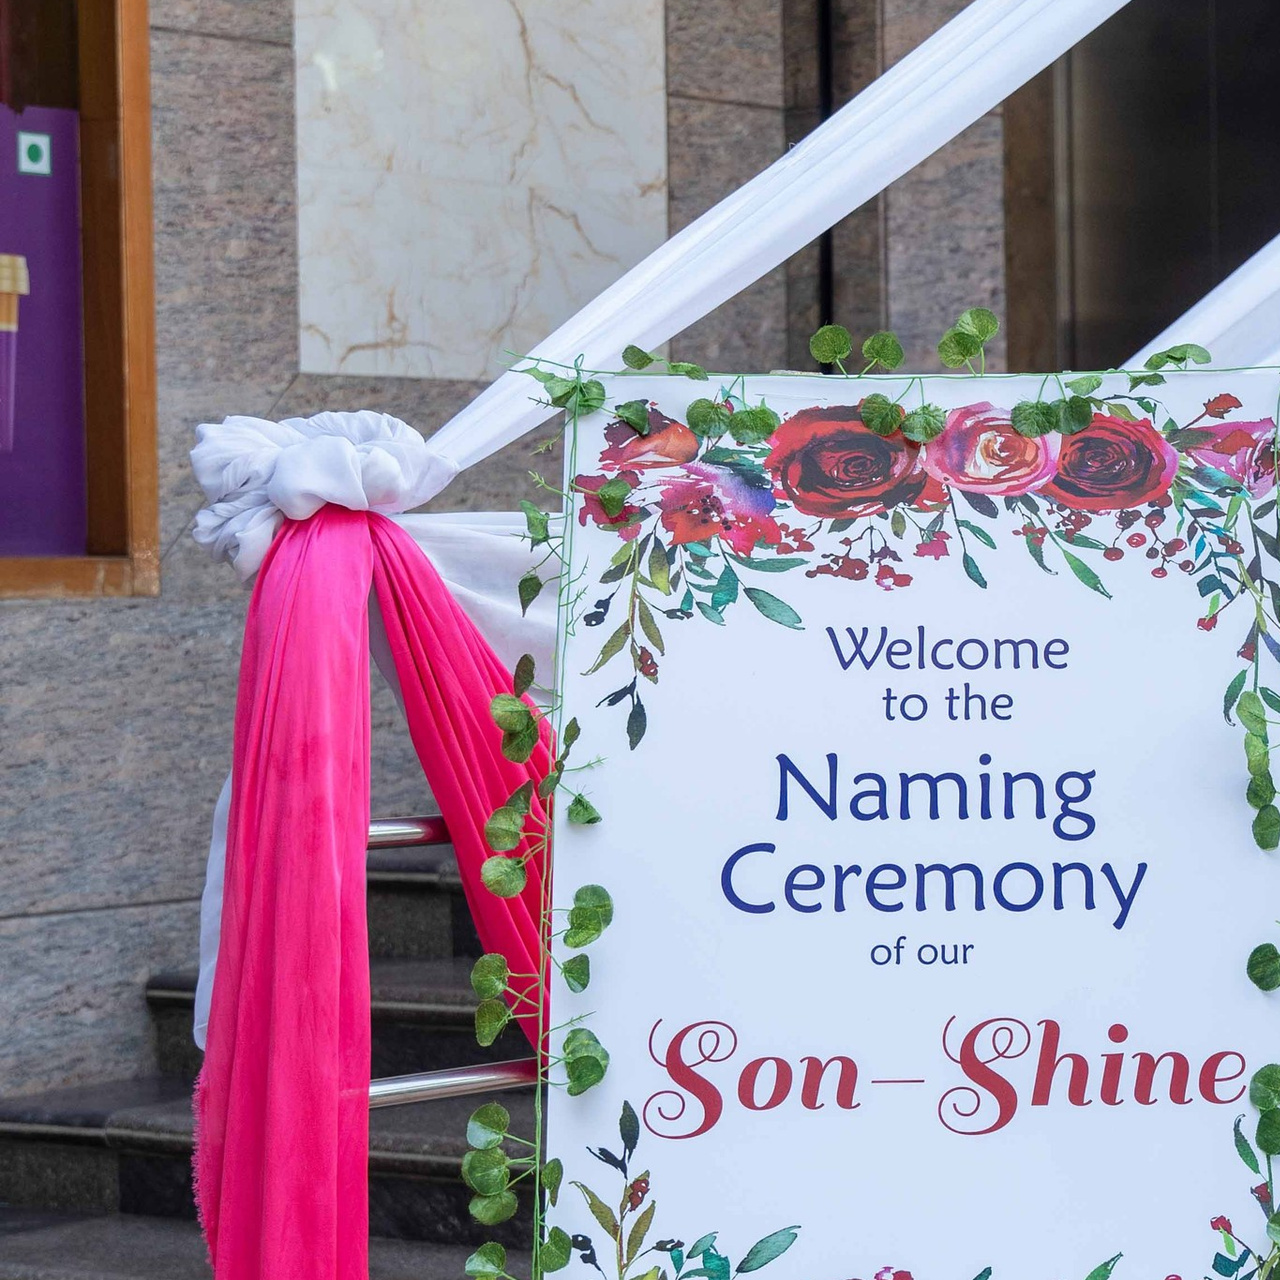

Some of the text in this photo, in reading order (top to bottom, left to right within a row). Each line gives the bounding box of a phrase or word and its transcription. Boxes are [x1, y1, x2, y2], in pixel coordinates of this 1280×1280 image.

[825, 625, 1070, 671] Welcome
[882, 683, 1014, 722] to the
[775, 753, 1097, 842] Naming
[720, 842, 1148, 931] Ceremony
[870, 936, 975, 966] of our
